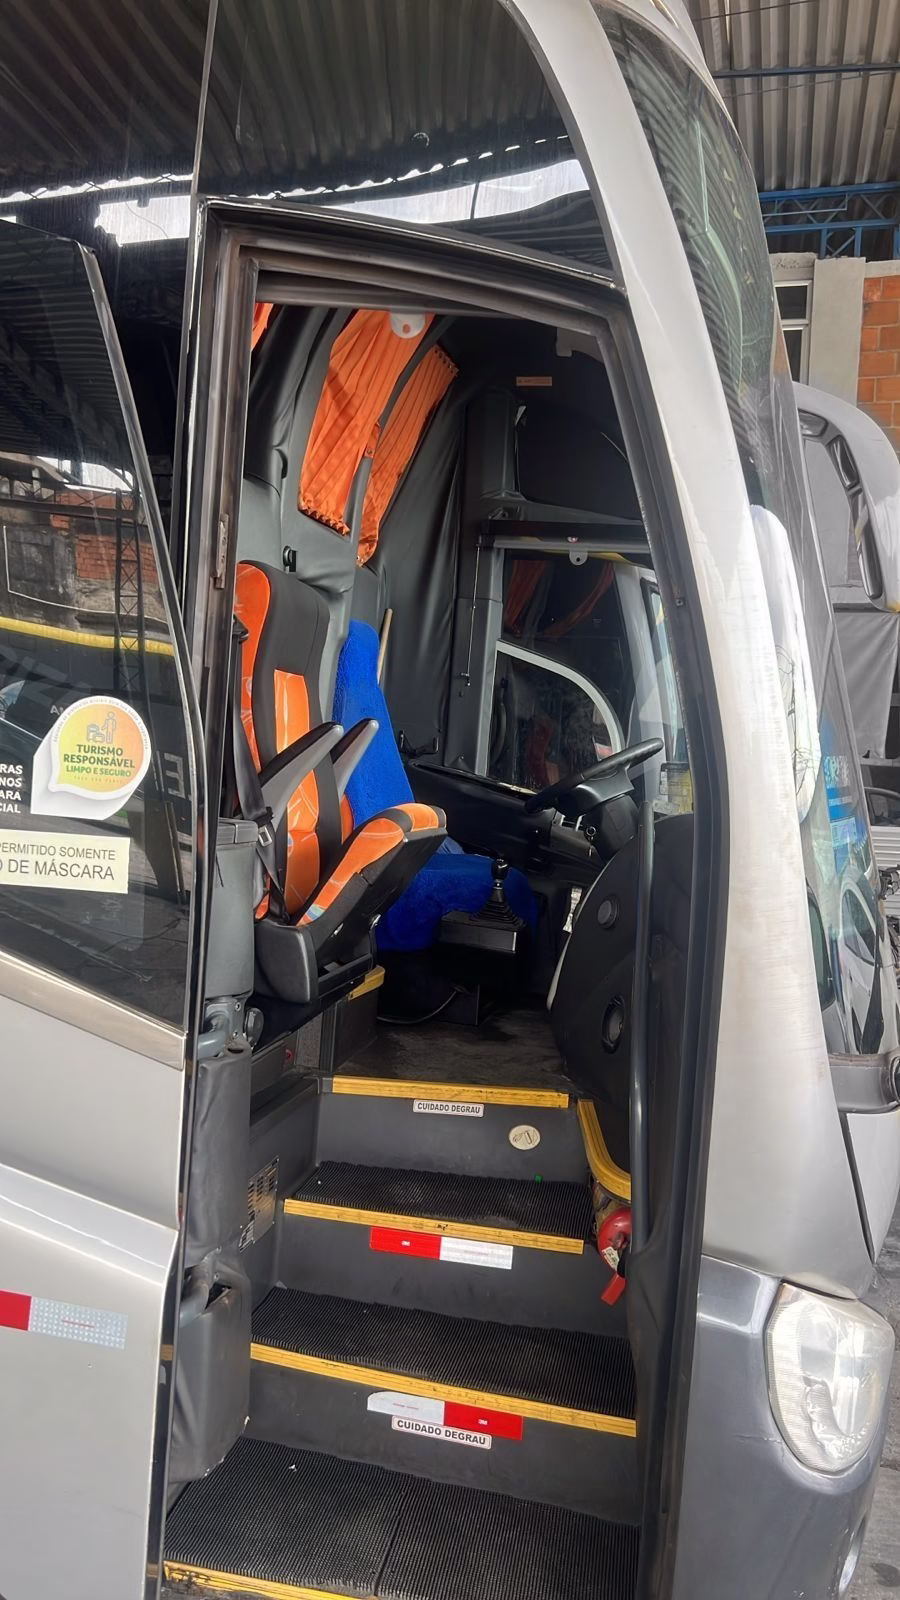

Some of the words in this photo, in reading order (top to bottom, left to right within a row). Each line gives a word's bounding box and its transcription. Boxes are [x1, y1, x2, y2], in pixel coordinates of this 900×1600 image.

[76, 744, 124, 757] TURISMO
[63, 753, 136, 769] RESPONSÁVEL
[66, 765, 92, 774] LIMPO
[93, 767, 98, 775] E
[99, 768, 132, 777] SEGURO
[0, 842, 57, 857] ERMITIDO
[59, 846, 116, 861] SOMENTE
[8, 859, 30, 874] DE
[34, 859, 115, 881] MÁSCARA
[417, 1102, 450, 1112] CUIDADO
[451, 1105, 481, 1114] DEGRAU
[397, 1419, 442, 1436] CUIDADO
[444, 1429, 486, 1445] DEGRAU
